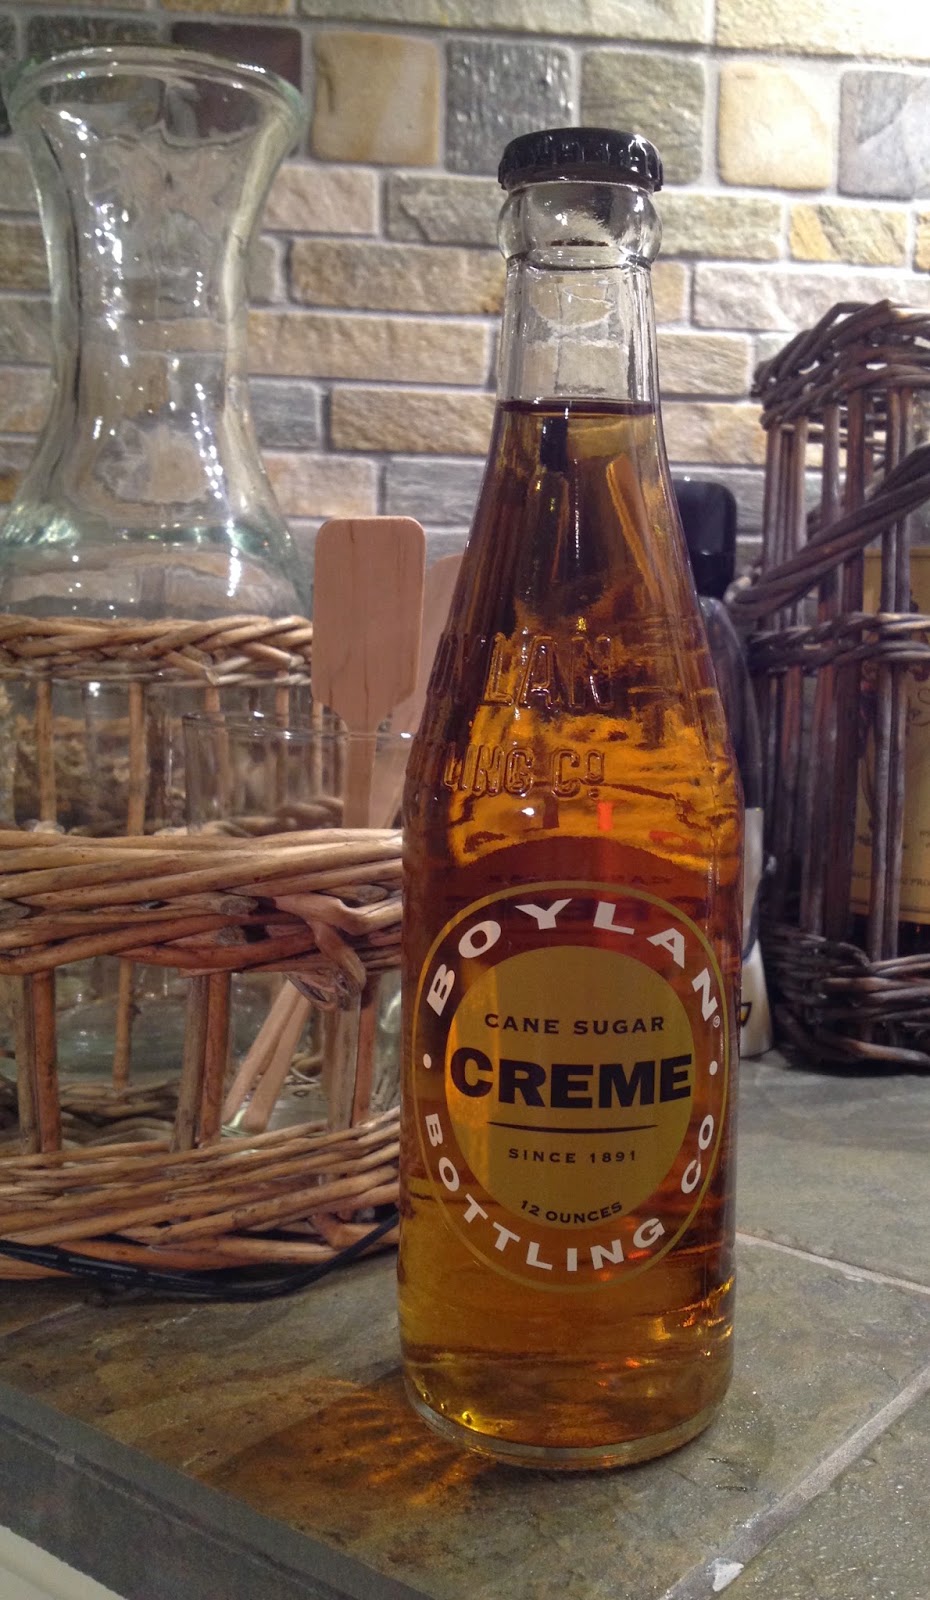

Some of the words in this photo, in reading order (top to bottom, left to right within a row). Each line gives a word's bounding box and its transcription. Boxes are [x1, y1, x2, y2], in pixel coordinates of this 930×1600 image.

[427, 898, 719, 1022] BOYLAN
[485, 1013, 560, 1035] CANE
[573, 1015, 665, 1036] SUGAR
[450, 1047, 693, 1109] CREME
[508, 1148, 577, 1164] SINCE
[589, 1149, 637, 1164] 1891
[424, 1113, 665, 1272] BOTTLING
[520, 1199, 540, 1217] 12
[545, 1201, 624, 1225] OUNCES
